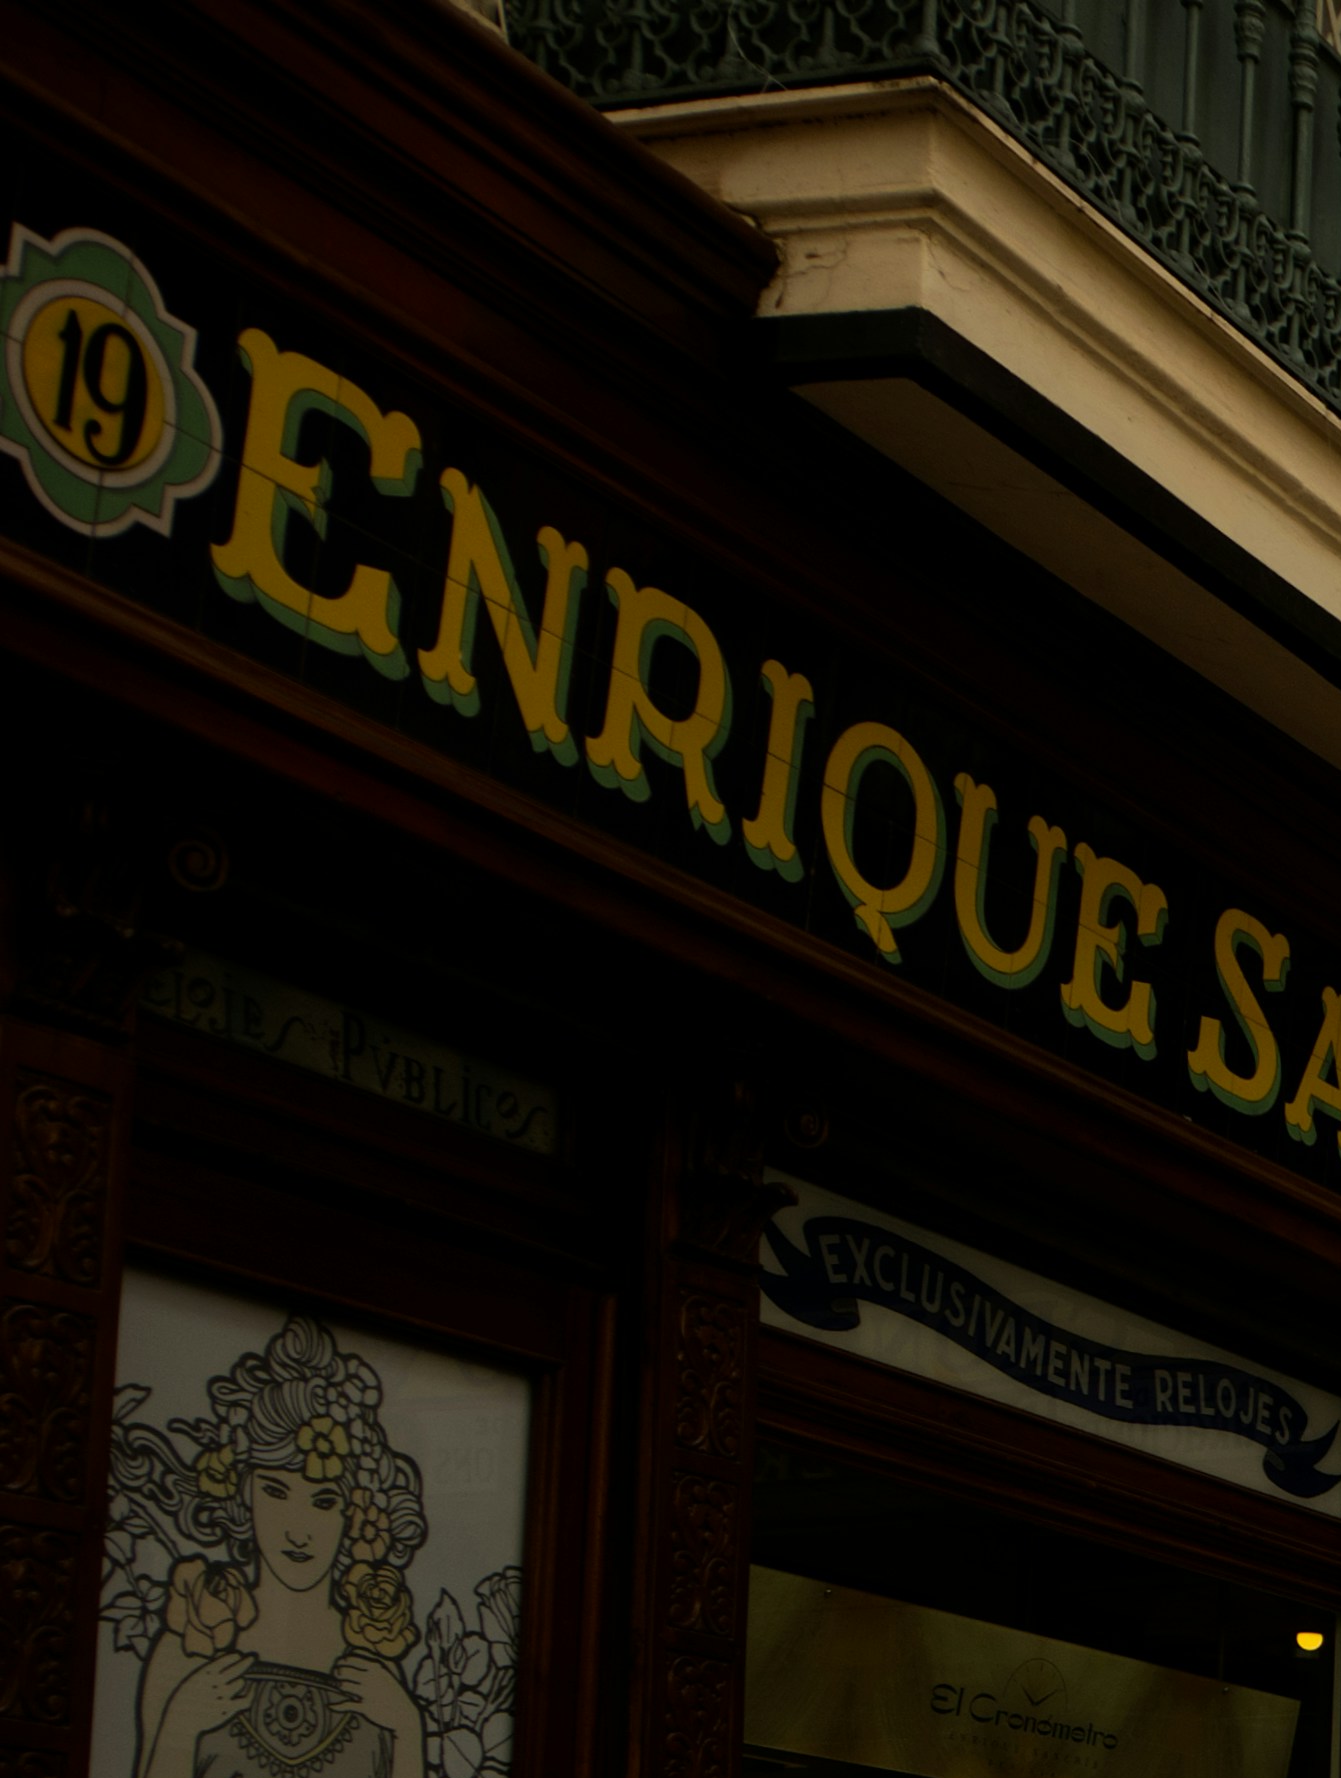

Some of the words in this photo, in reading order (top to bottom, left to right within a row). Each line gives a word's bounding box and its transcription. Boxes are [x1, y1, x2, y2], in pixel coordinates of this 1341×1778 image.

[52, 308, 149, 468] 19
[211, 328, 1168, 1060] ENRIQUE
[817, 1232, 1134, 1409] EXCLUSIVAMENTE
[1154, 1369, 1294, 1447] RELOJES
[930, 1683, 964, 1716] El
